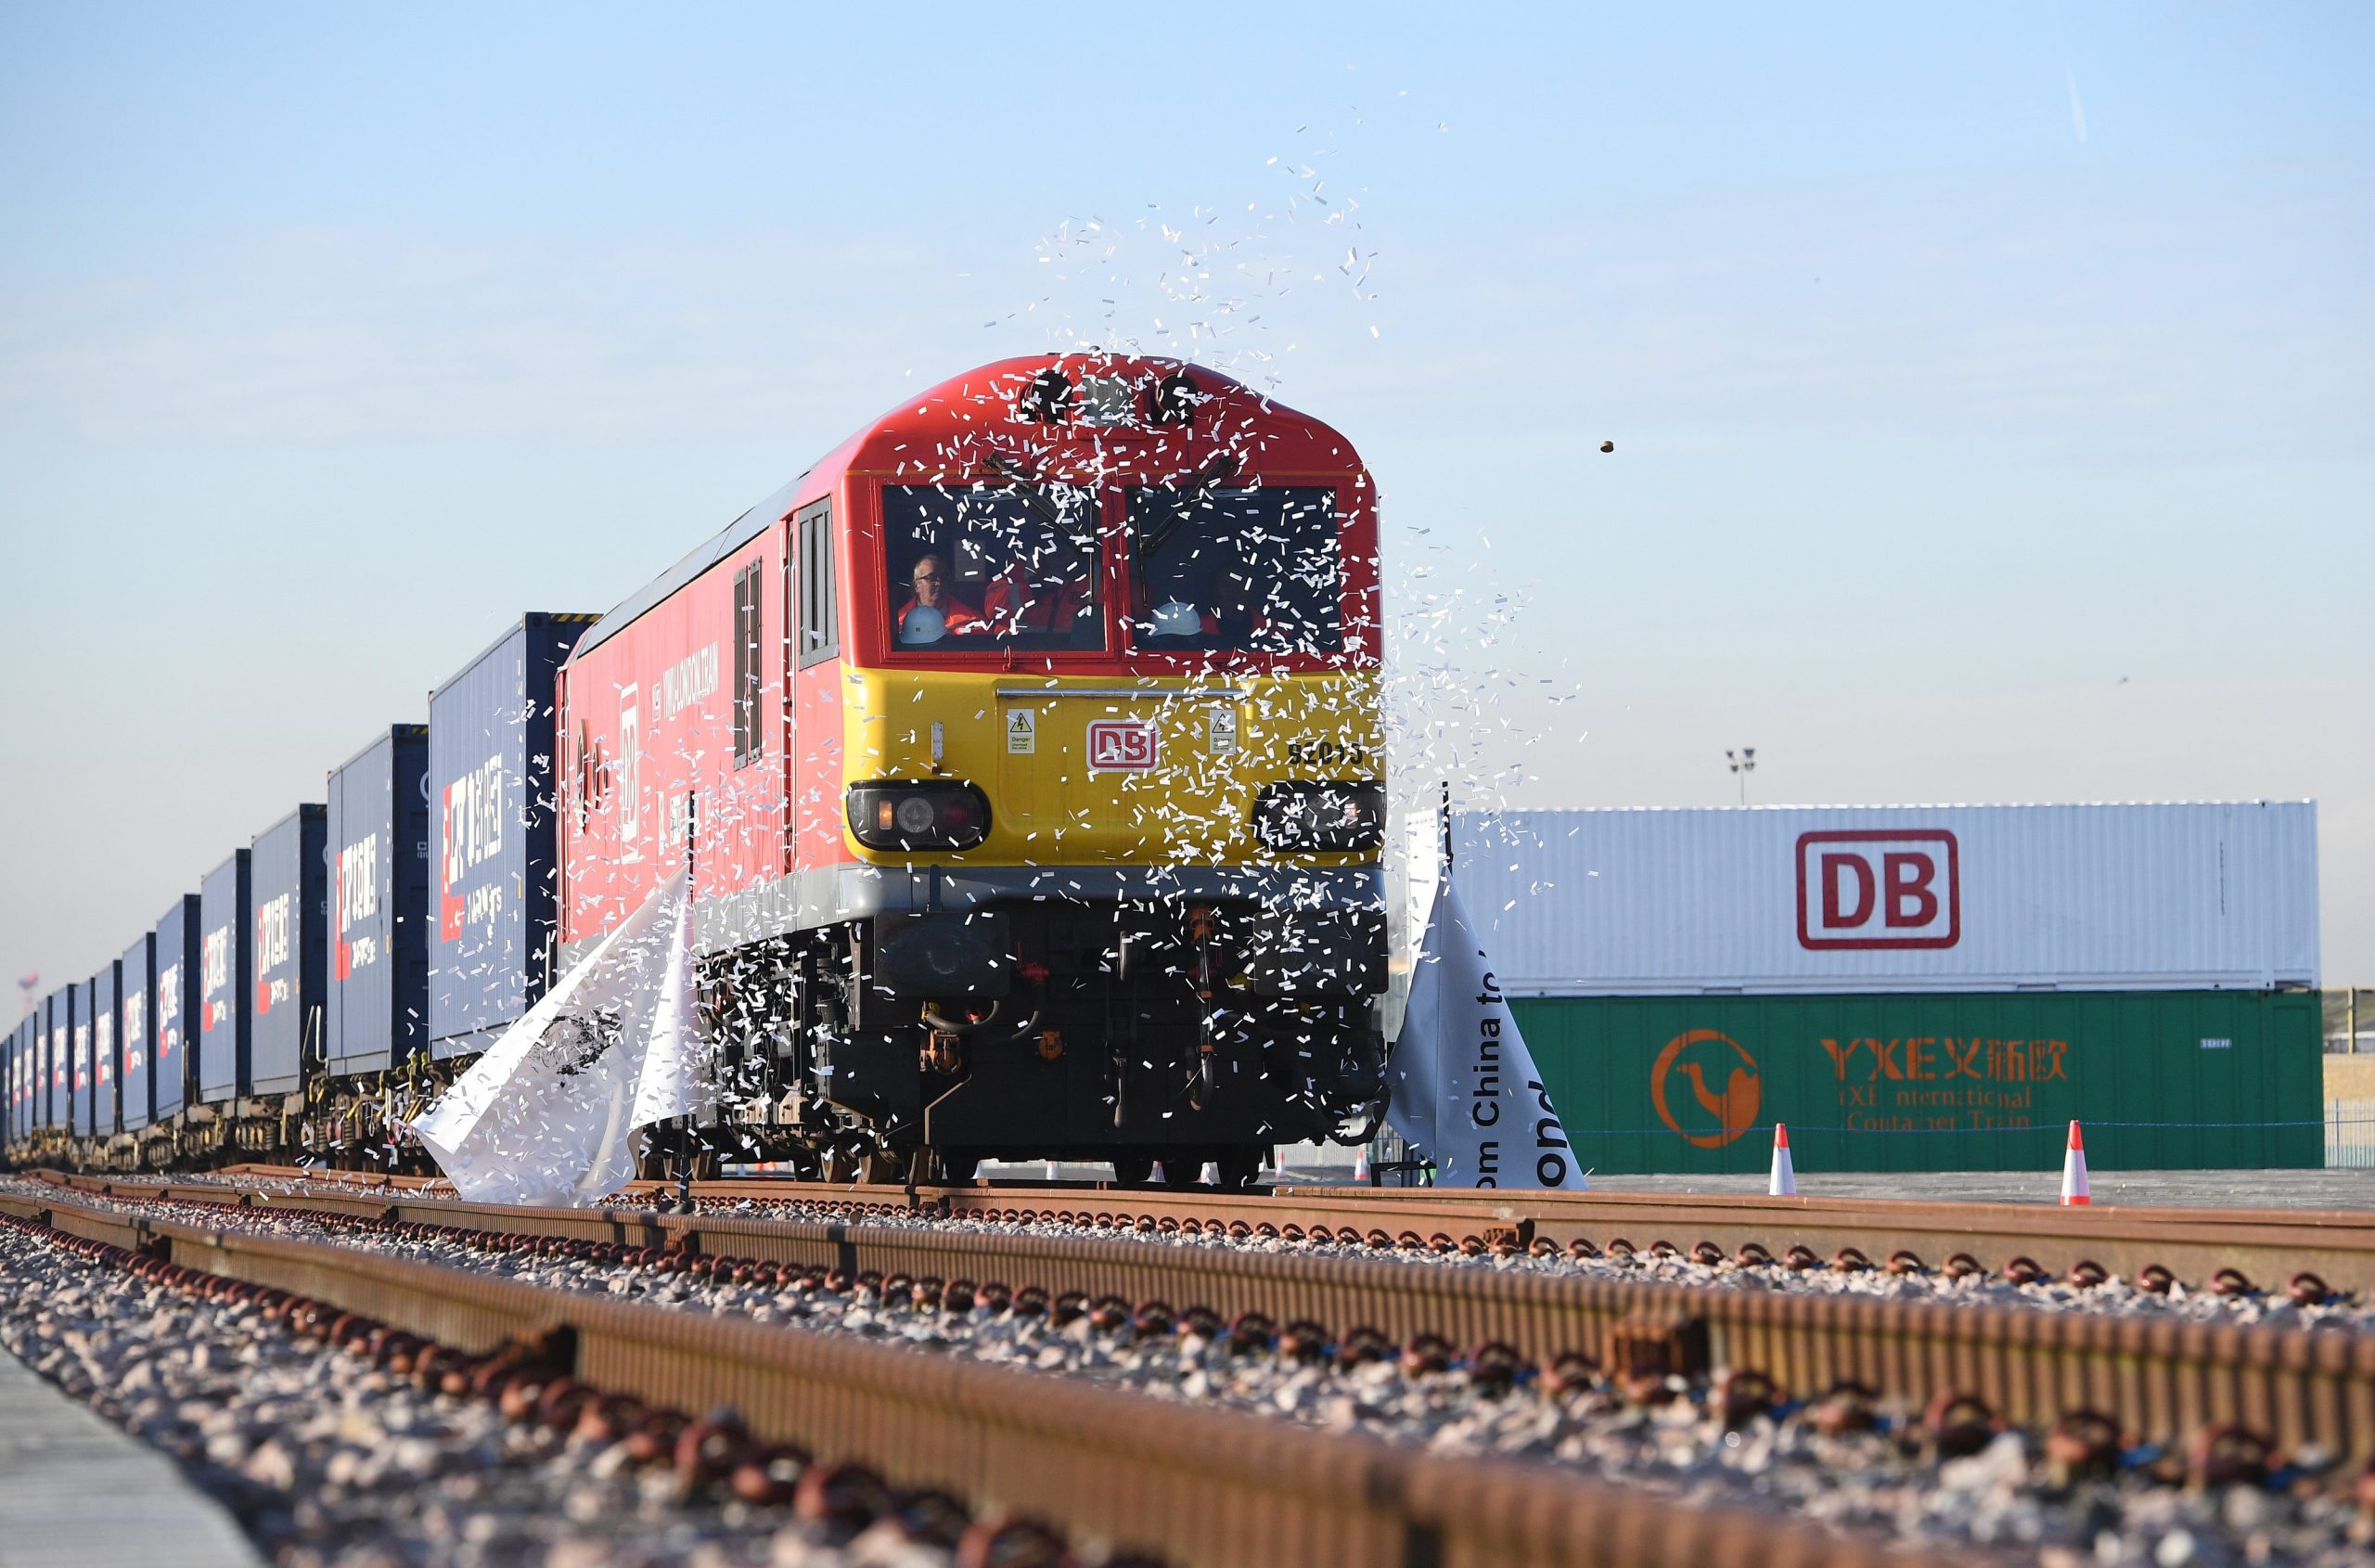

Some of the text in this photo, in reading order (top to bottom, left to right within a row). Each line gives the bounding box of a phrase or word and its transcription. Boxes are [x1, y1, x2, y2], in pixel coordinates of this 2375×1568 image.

[1098, 730, 1148, 761] DB
[1288, 741, 1363, 765] 92015
[1822, 852, 1938, 929] DB
[1475, 971, 1504, 1005] to
[1471, 1018, 1501, 1127] China
[1894, 1085, 2032, 1108] nterntional
[1846, 1111, 2031, 1133] Contaner Trin
